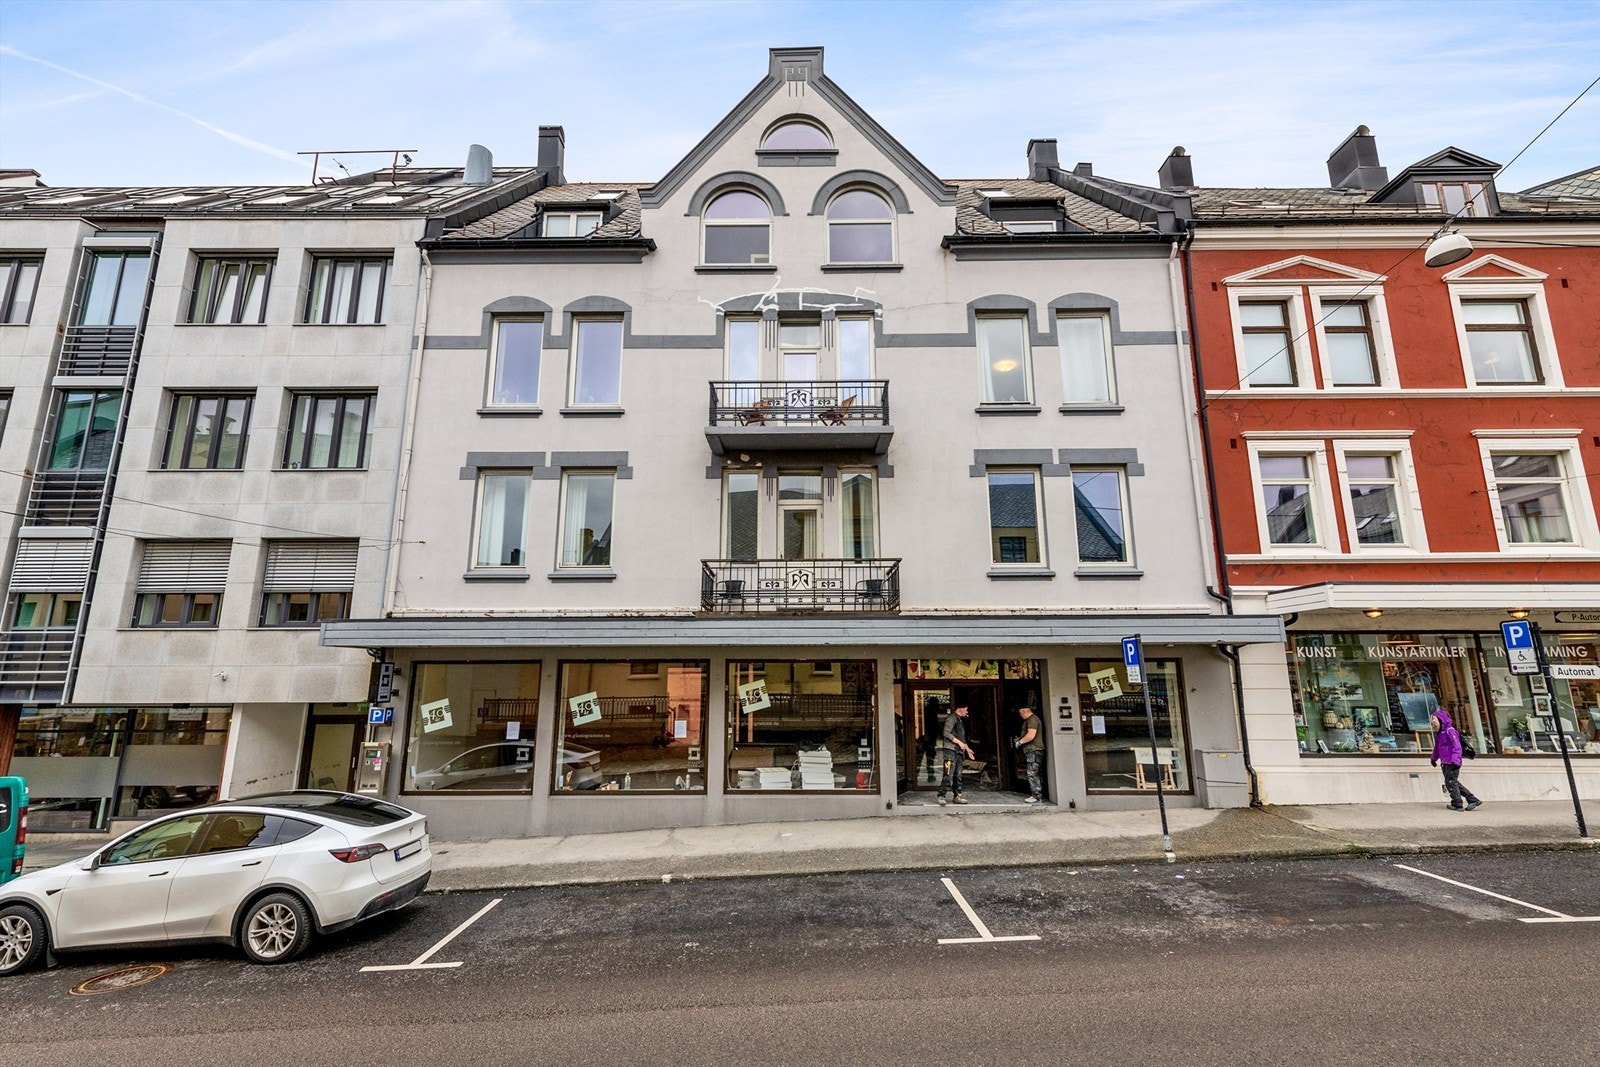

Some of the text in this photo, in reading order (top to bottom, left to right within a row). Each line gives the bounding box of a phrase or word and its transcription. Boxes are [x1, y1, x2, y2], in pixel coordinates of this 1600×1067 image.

[1509, 626, 1523, 646] P
[1127, 643, 1135, 663] P
[1297, 646, 1337, 658] KUNST
[1368, 646, 1466, 658] KUNSTARTIKLER
[1558, 668, 1595, 676] Automat
[372, 710, 382, 721] P
